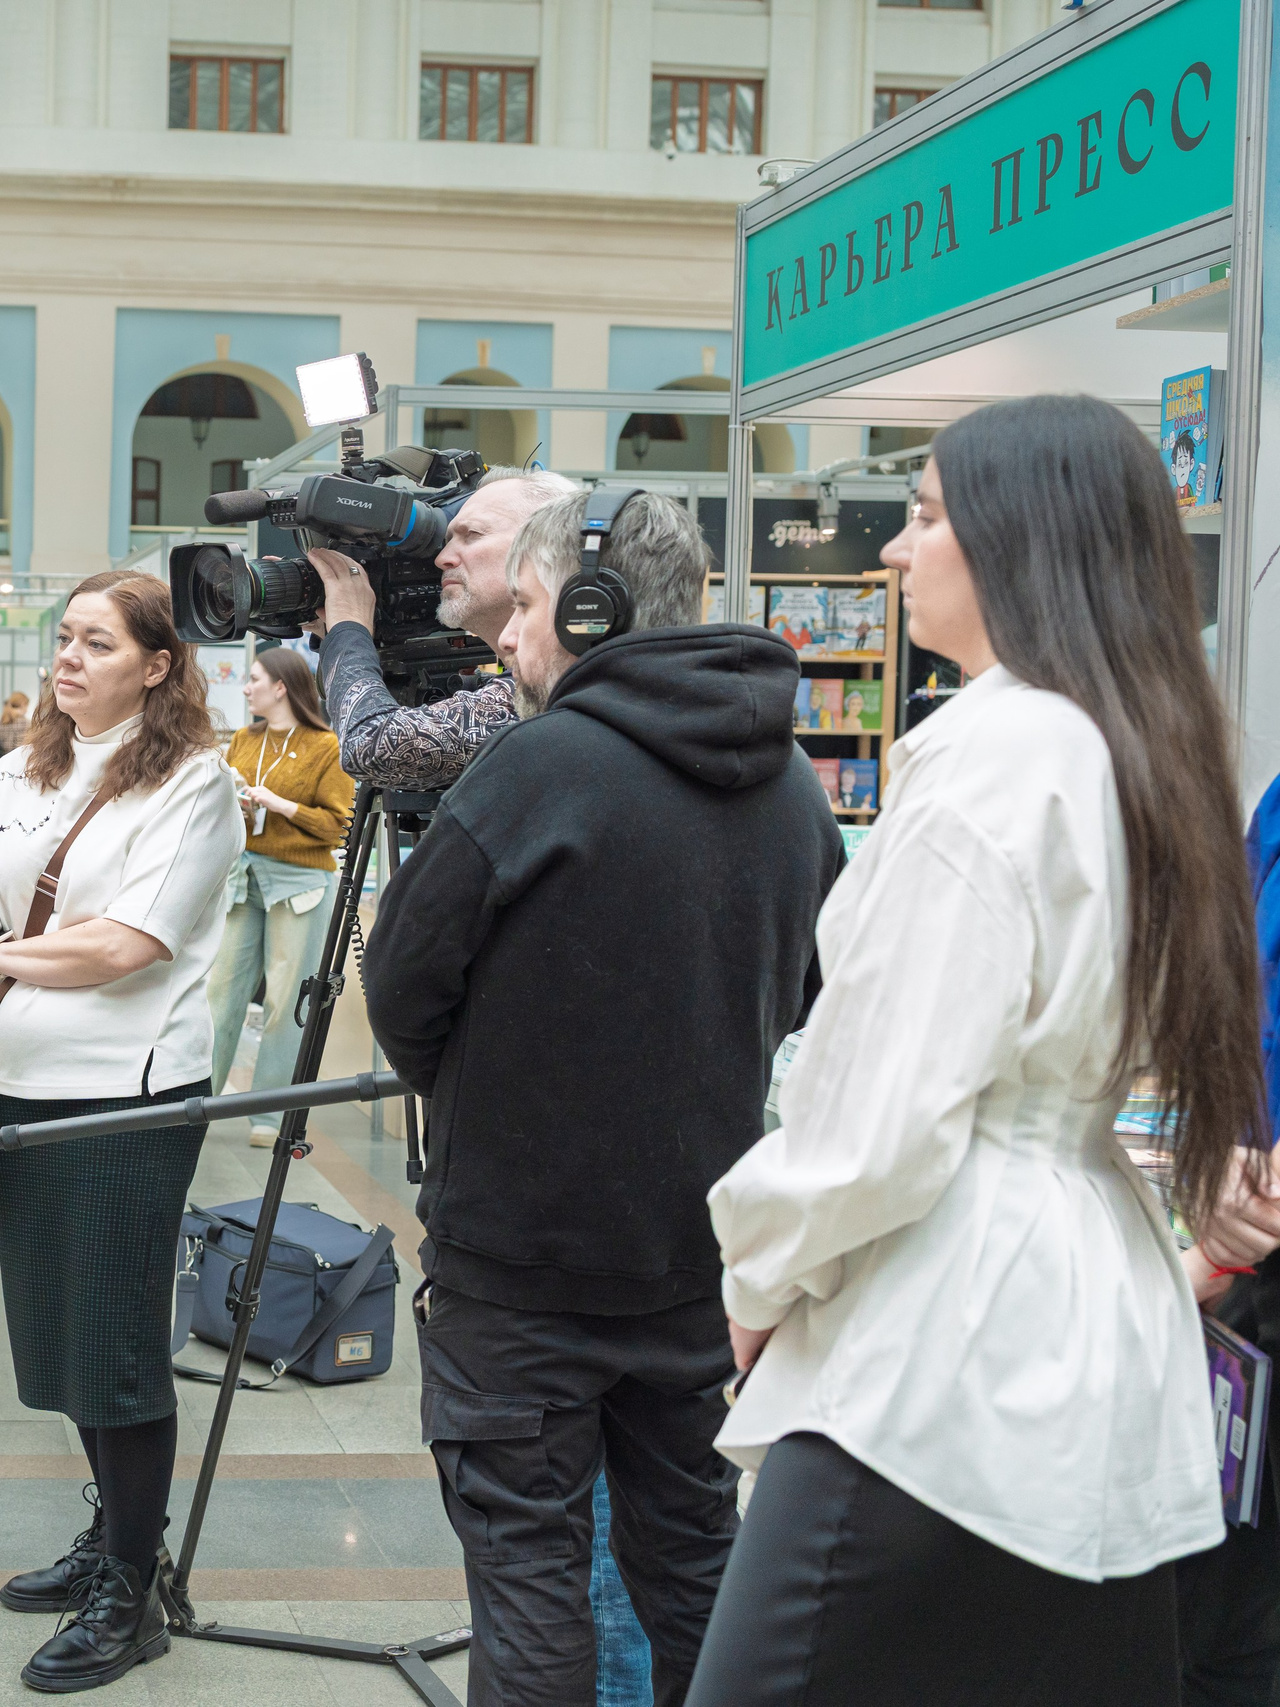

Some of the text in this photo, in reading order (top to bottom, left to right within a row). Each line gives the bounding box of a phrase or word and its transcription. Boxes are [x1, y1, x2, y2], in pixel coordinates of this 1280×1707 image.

[764, 61, 1212, 334] КАРЬЕРА ПРЕСС
[1166, 374, 1204, 400] СРЕДНЯЯ
[336, 496, 373, 510] XDCAM
